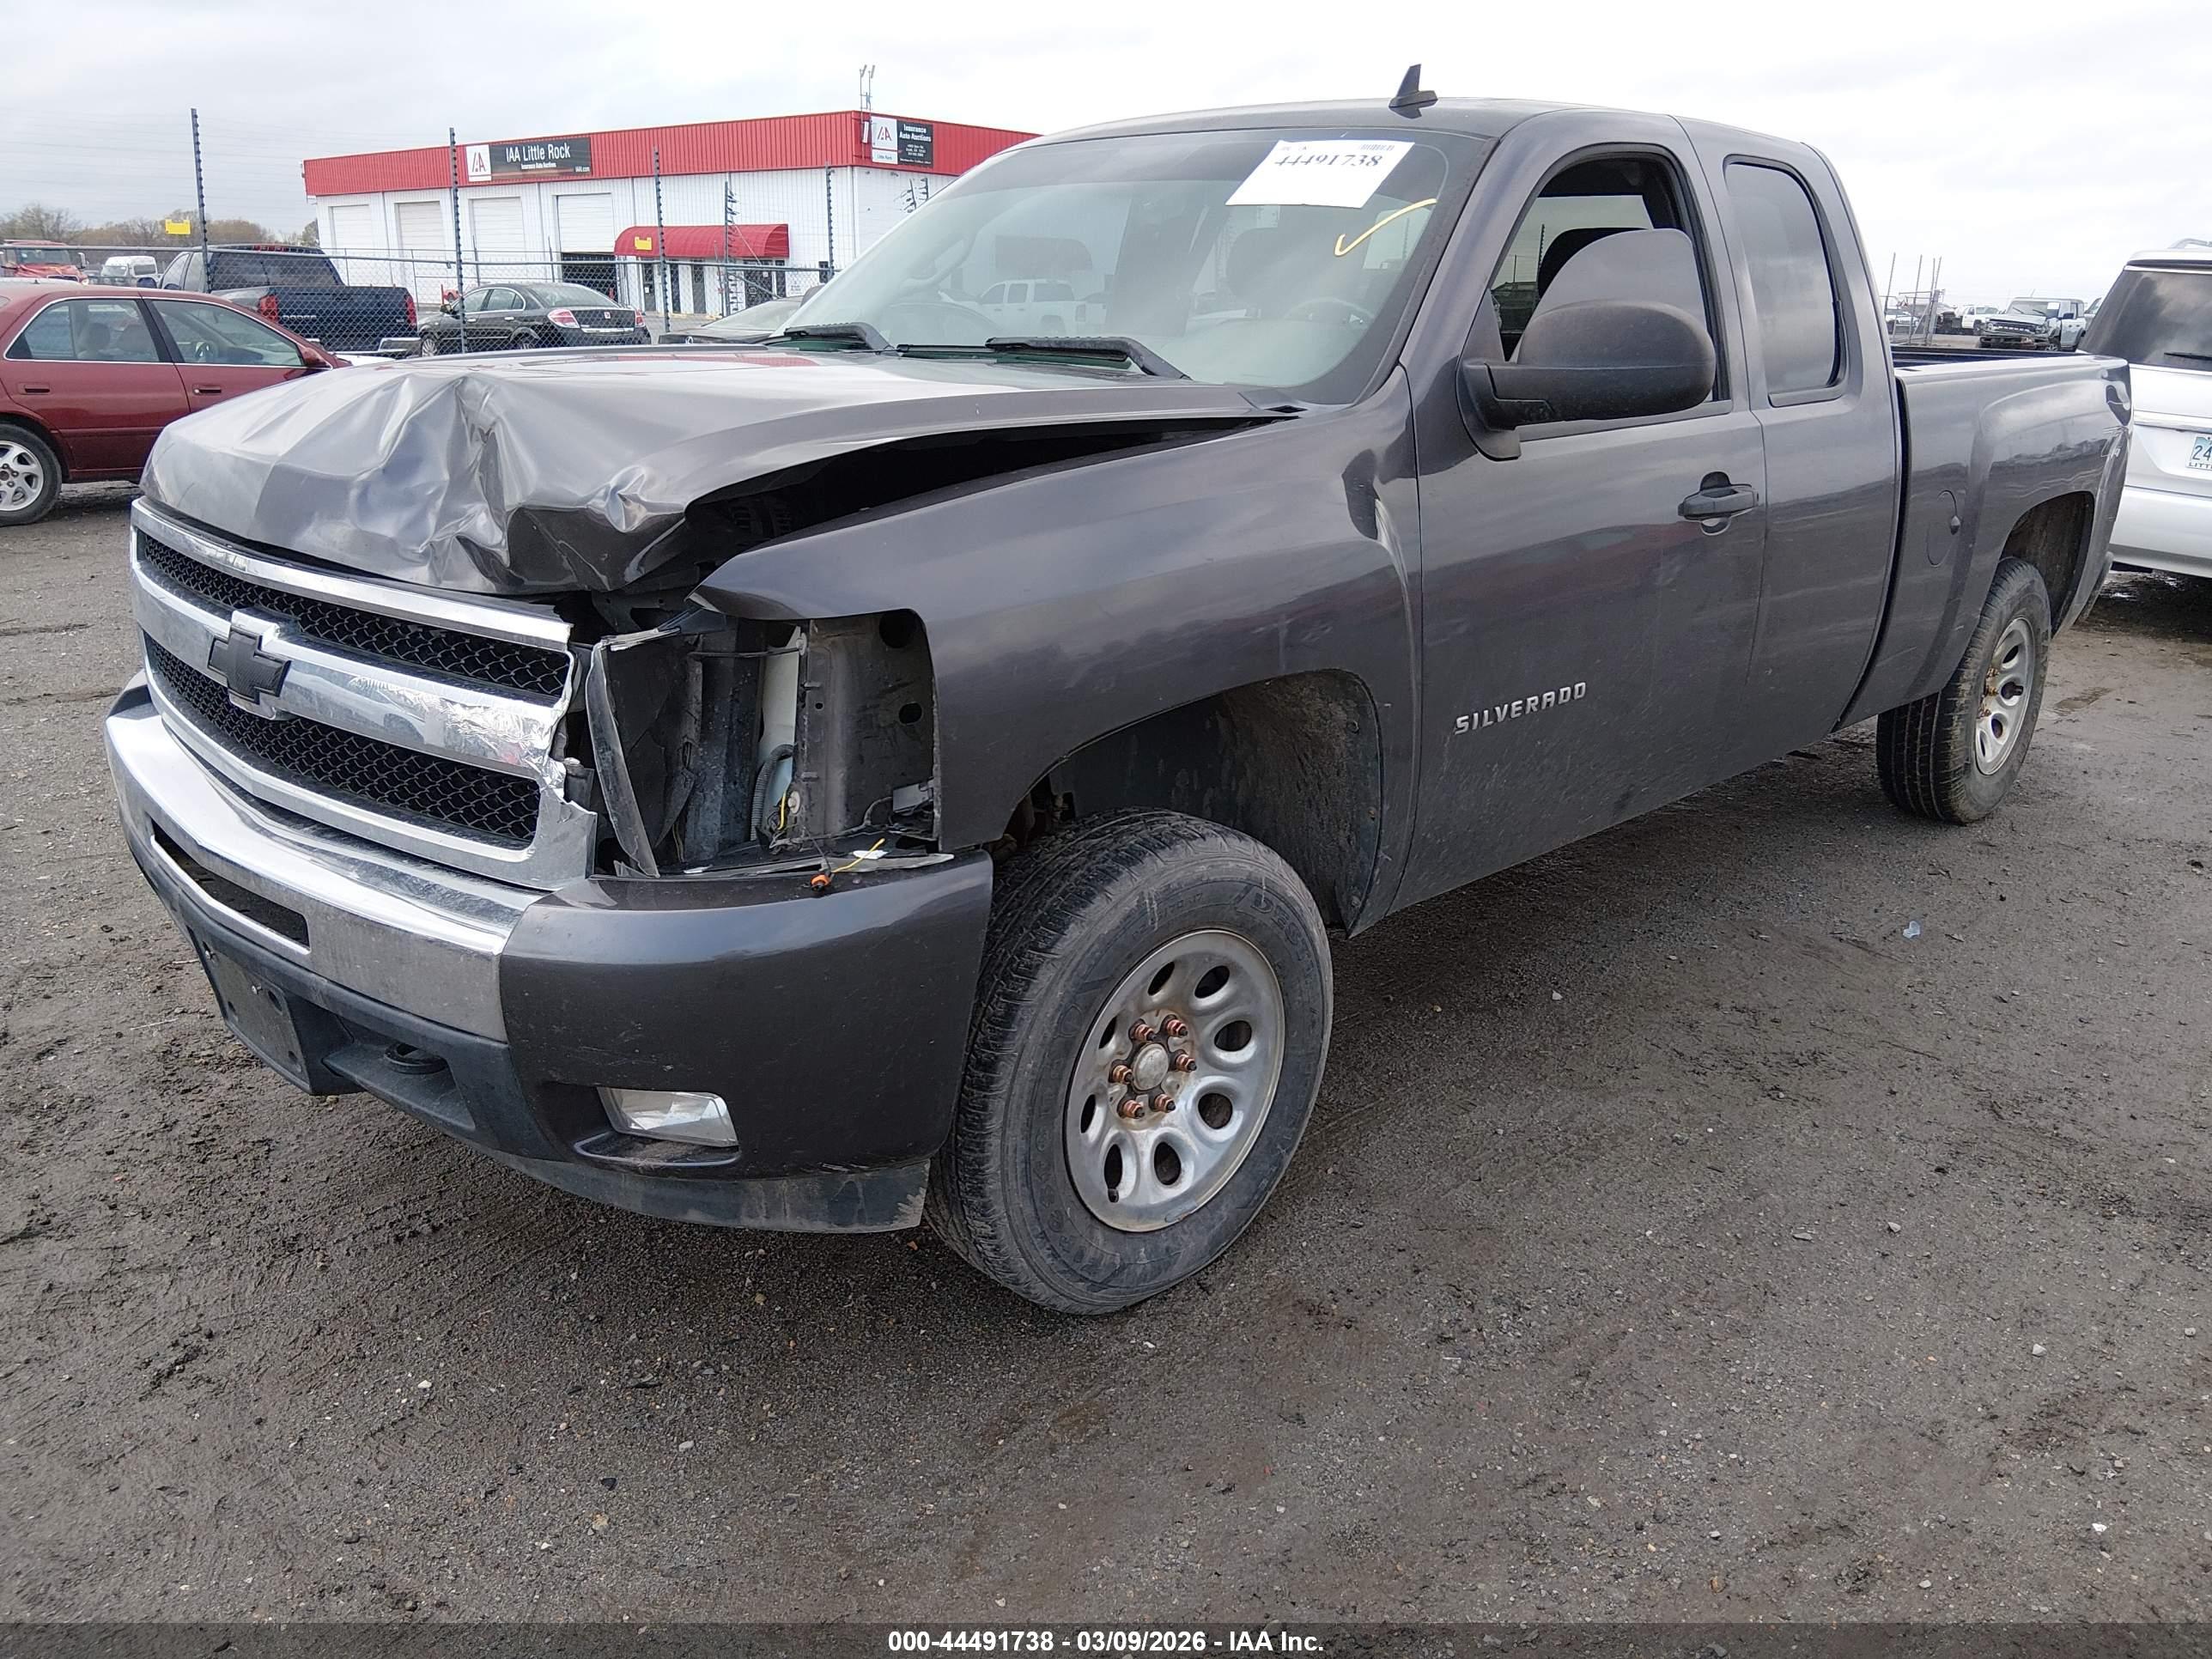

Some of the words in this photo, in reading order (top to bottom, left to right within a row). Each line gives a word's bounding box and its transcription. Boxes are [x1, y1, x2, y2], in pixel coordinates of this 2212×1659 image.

[506, 146, 521, 163] IAA
[522, 144, 545, 161] Little
[548, 143, 570, 159] Rock
[1274, 155, 1383, 167] 44491738
[1454, 682, 1586, 735] SILVERADO
